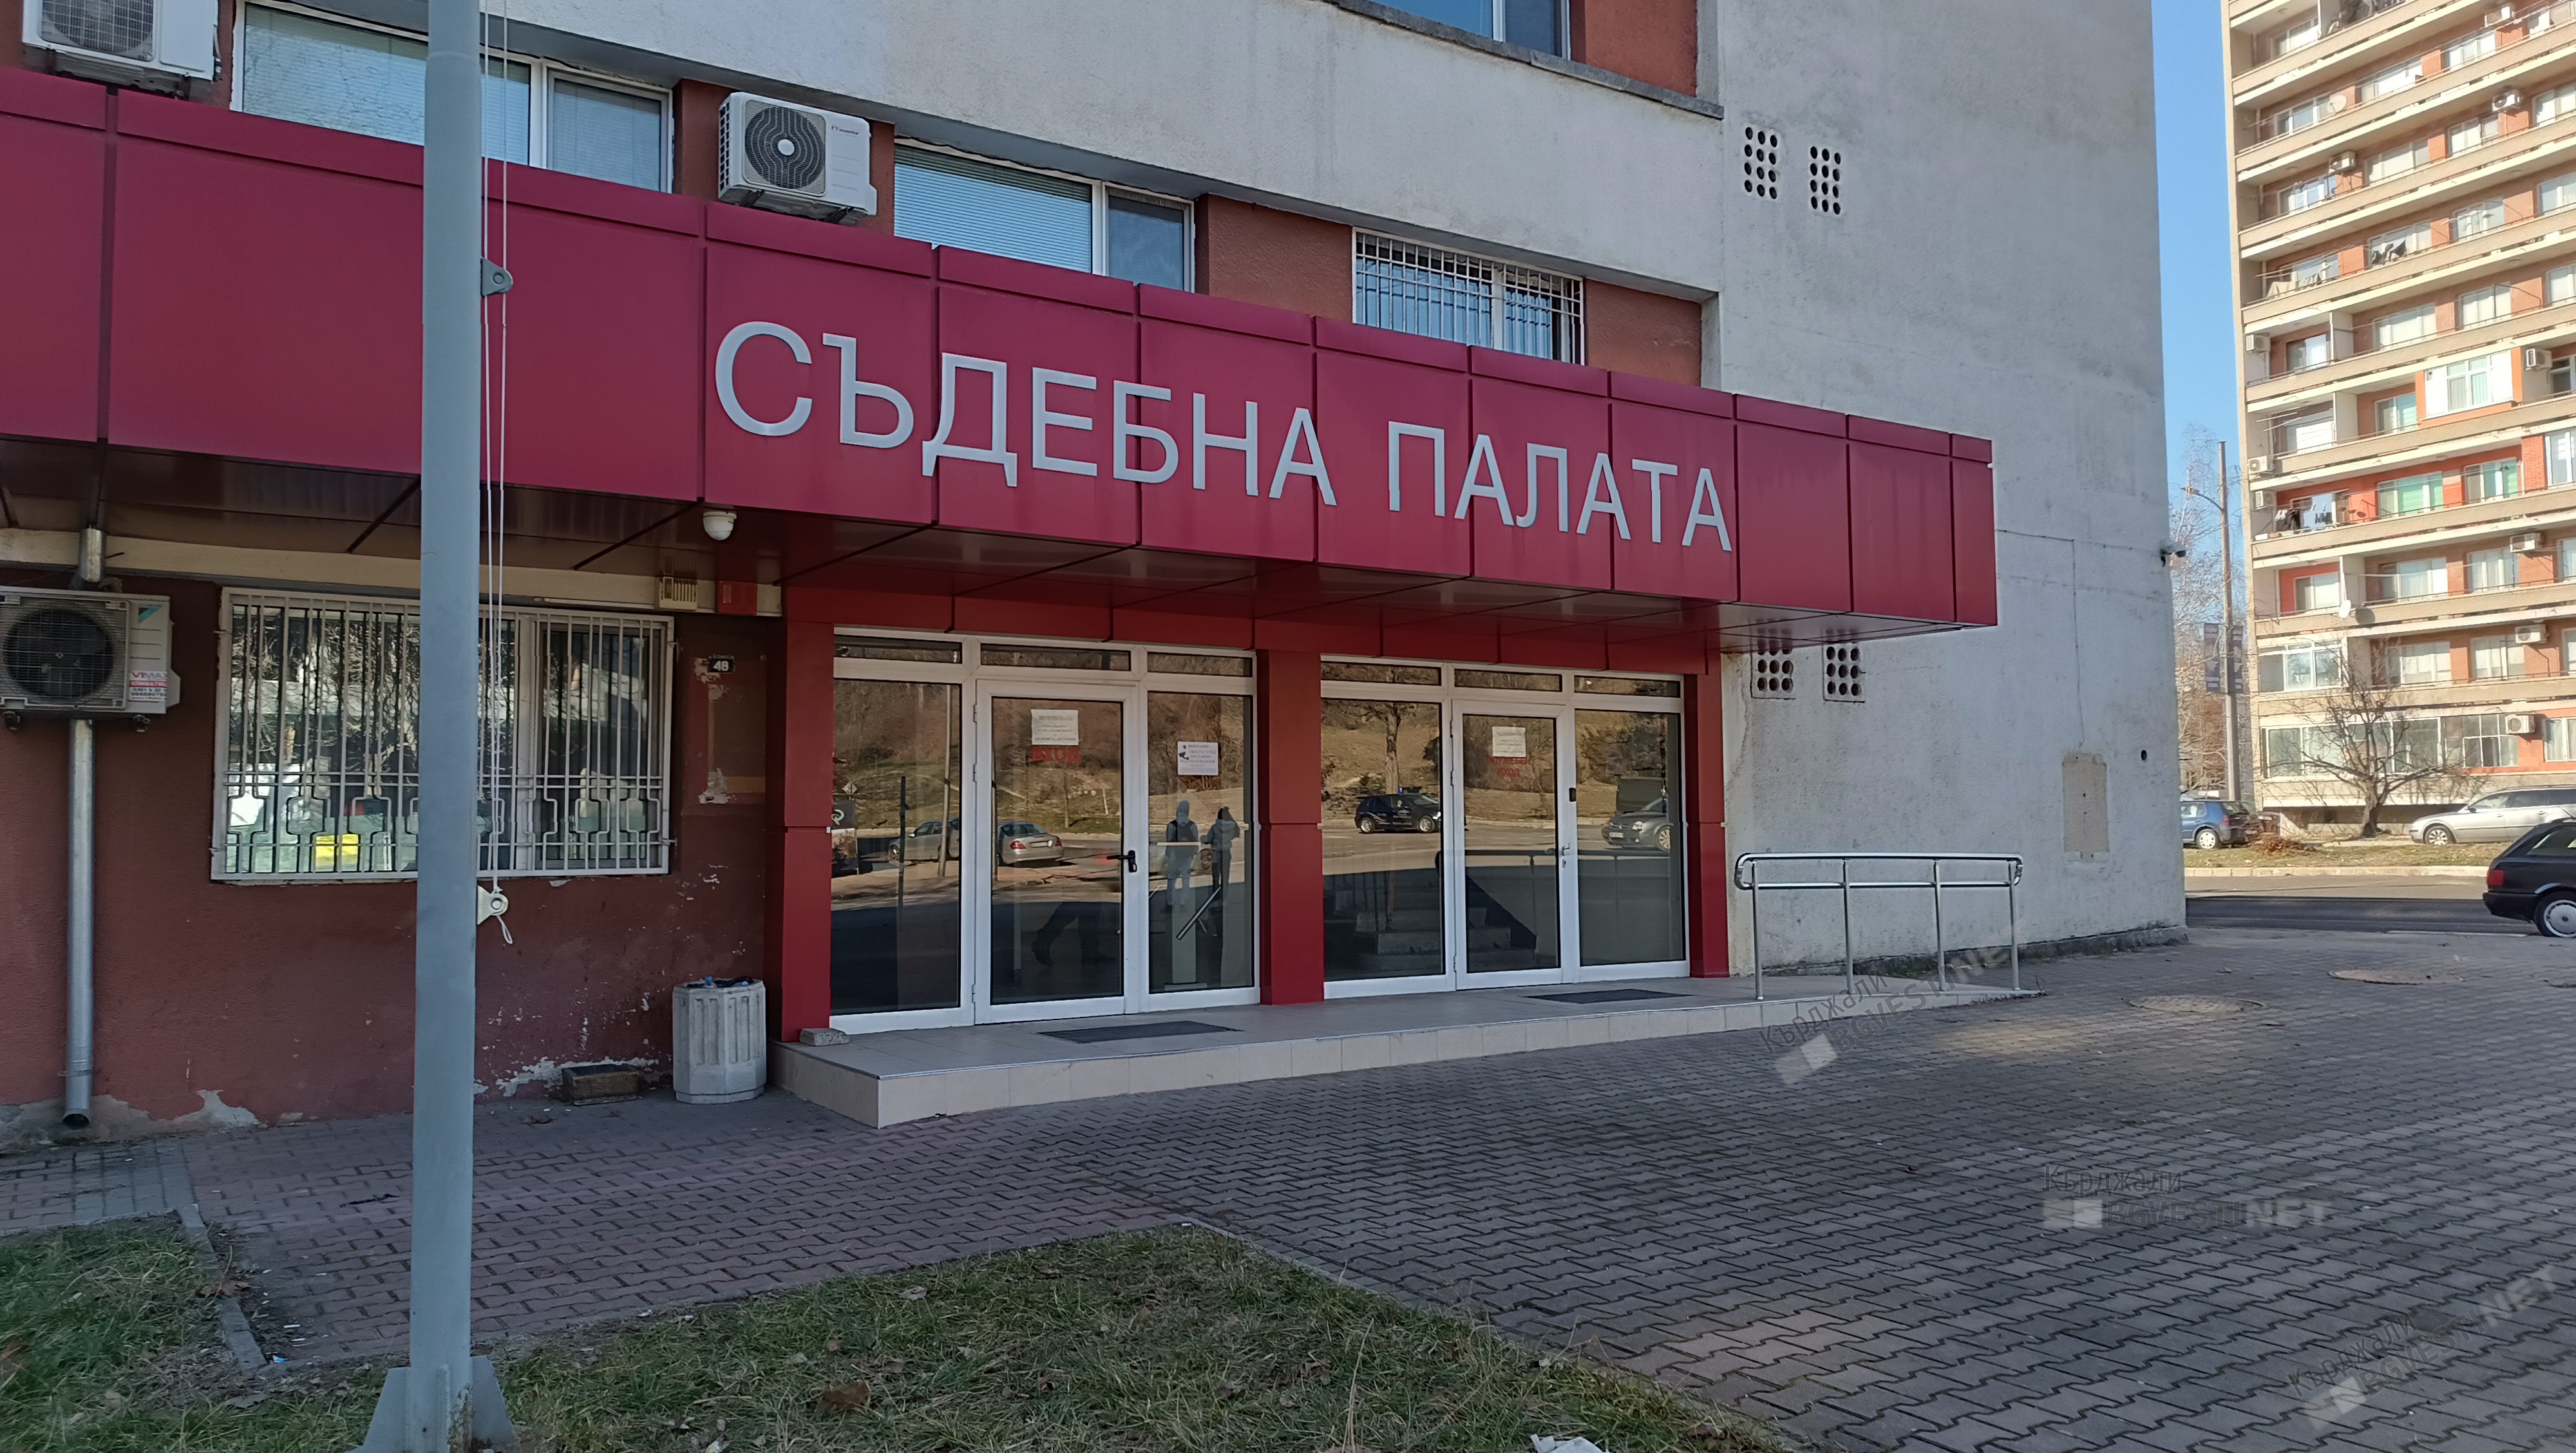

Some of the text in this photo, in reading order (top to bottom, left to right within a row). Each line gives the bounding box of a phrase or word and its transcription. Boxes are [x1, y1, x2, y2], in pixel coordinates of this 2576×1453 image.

[714, 321, 1734, 553] СЪДЕБНА ПАЛАТА
[713, 660, 729, 672] 48
[1031, 746, 1081, 763] ВХОД
